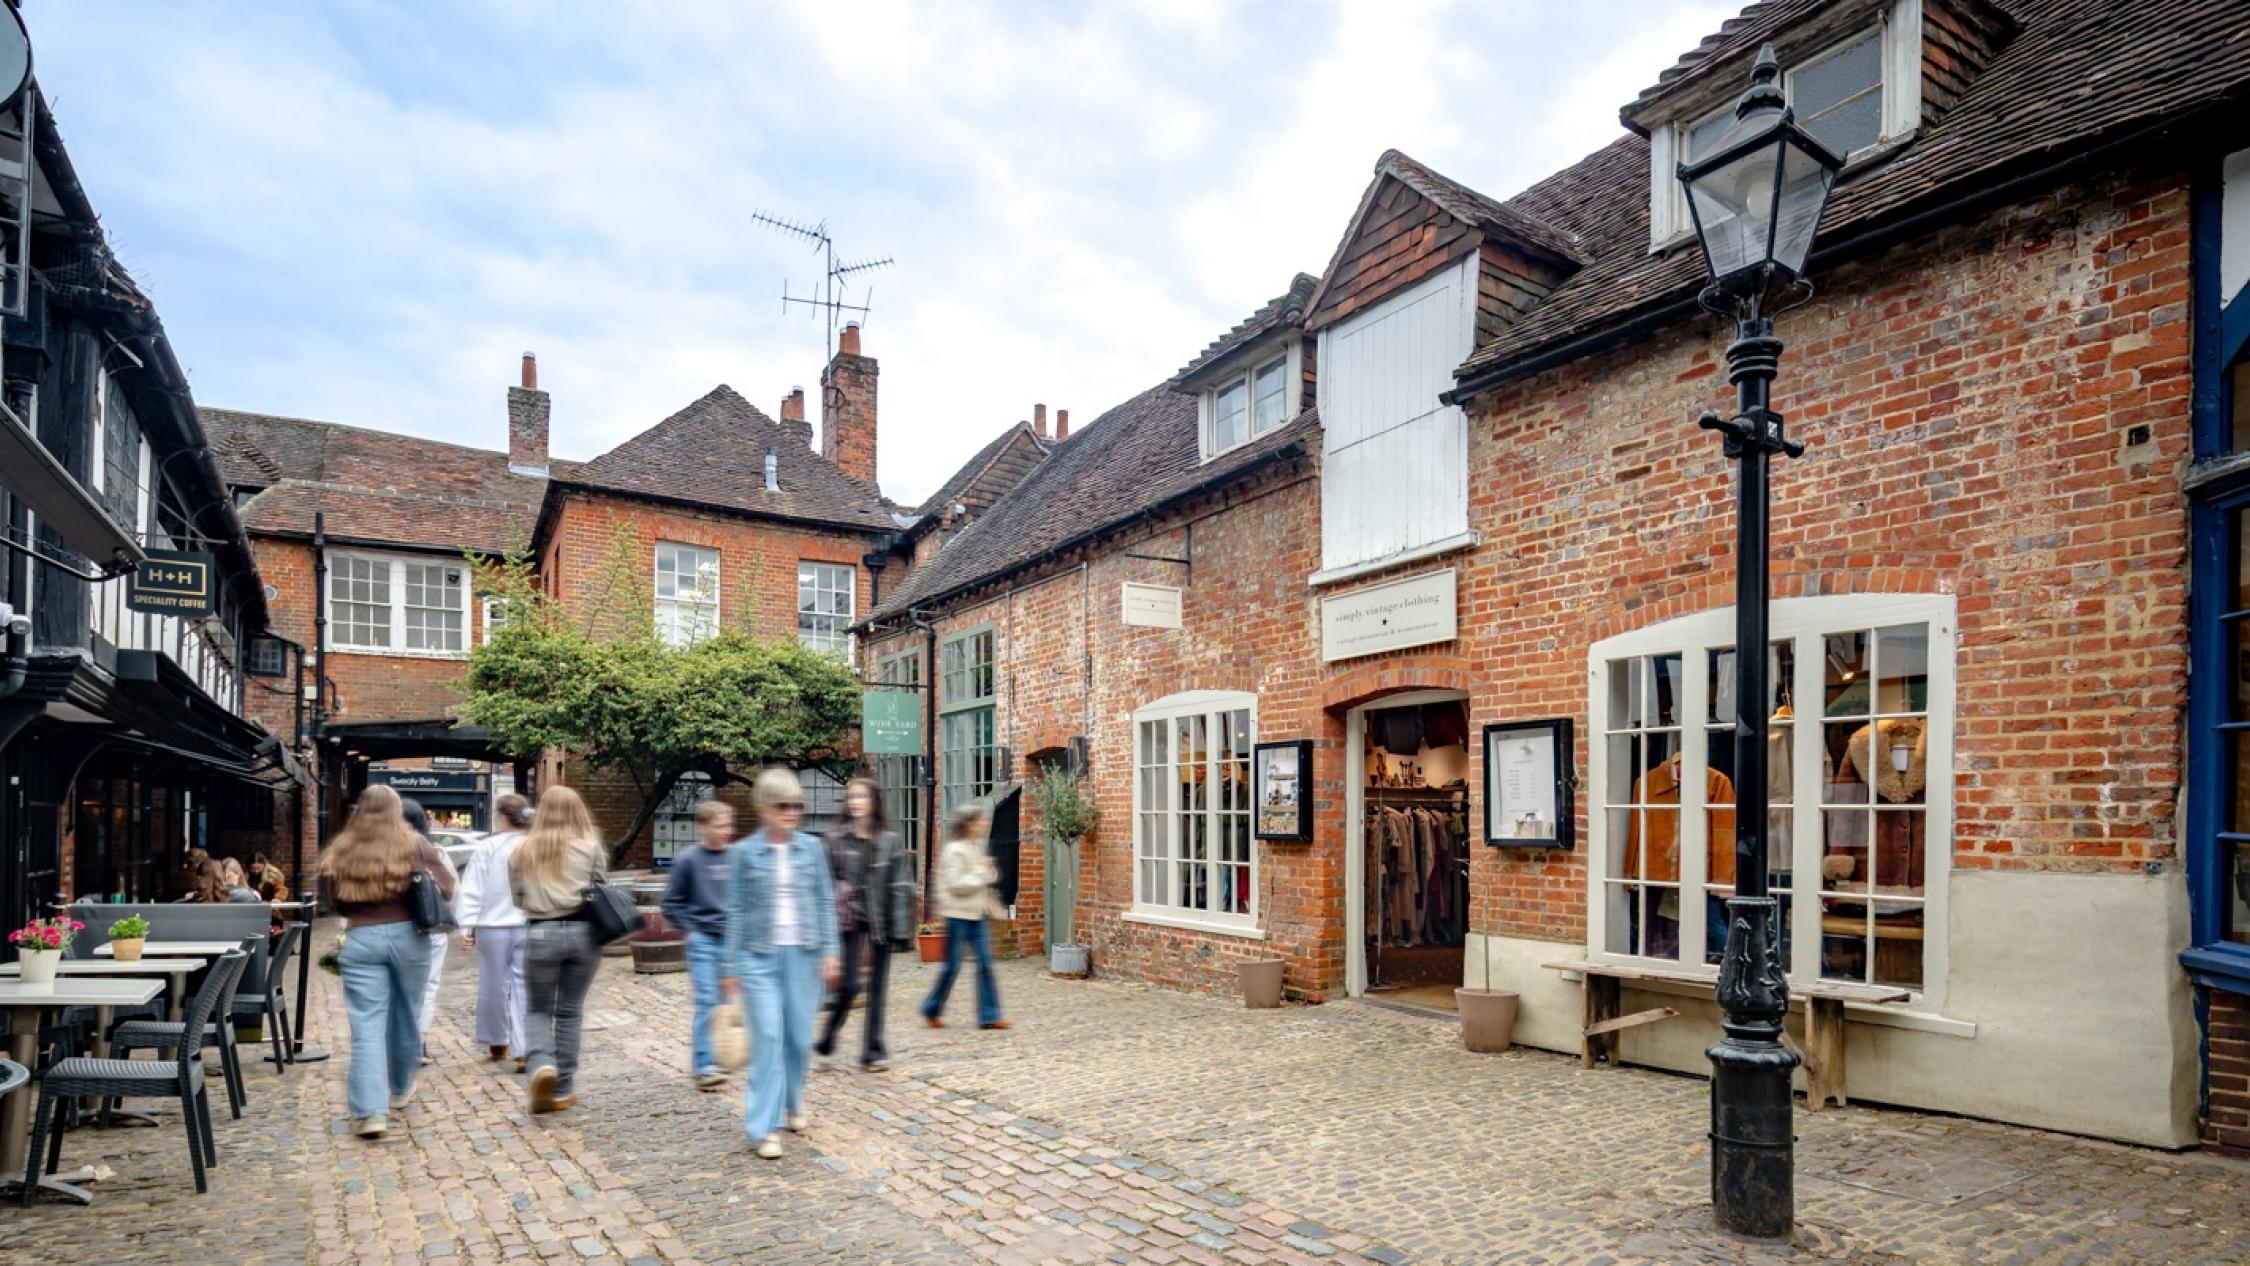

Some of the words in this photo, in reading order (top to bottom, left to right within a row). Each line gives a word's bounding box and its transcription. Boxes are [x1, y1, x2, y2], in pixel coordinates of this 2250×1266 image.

[148, 568, 193, 585] H+H
[134, 594, 177, 607] SPECIALITY
[178, 599, 207, 609] COFFEE
[1335, 608, 1362, 622] simply
[1365, 603, 1397, 616] vintage
[1399, 594, 1440, 609] clothing
[868, 719, 890, 728] WINE
[895, 720, 917, 729] YARD
